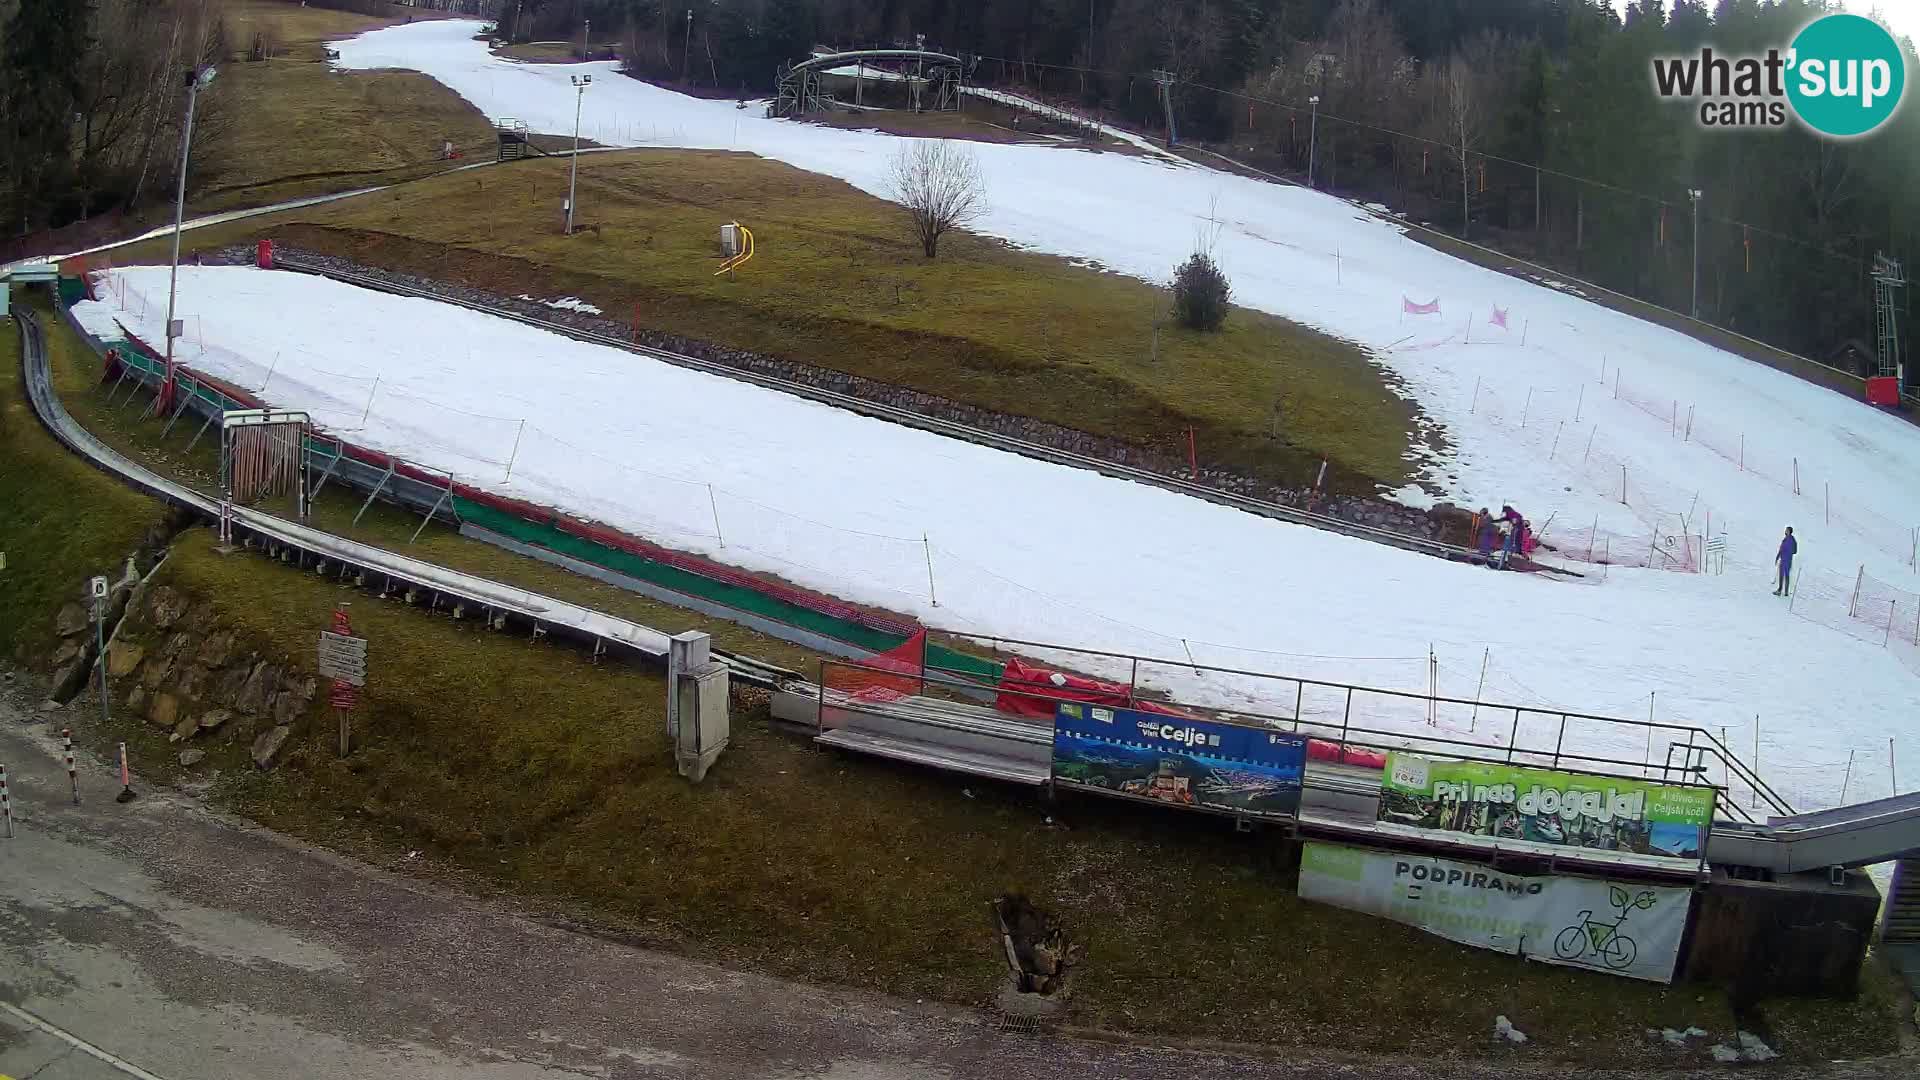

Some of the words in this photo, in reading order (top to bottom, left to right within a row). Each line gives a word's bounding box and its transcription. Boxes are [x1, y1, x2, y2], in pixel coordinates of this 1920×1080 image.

[1160, 725, 1206, 746] Celje
[1432, 779, 1468, 802] Pri
[1473, 783, 1516, 803] nas
[1395, 861, 1543, 895] PODPIRAMO
